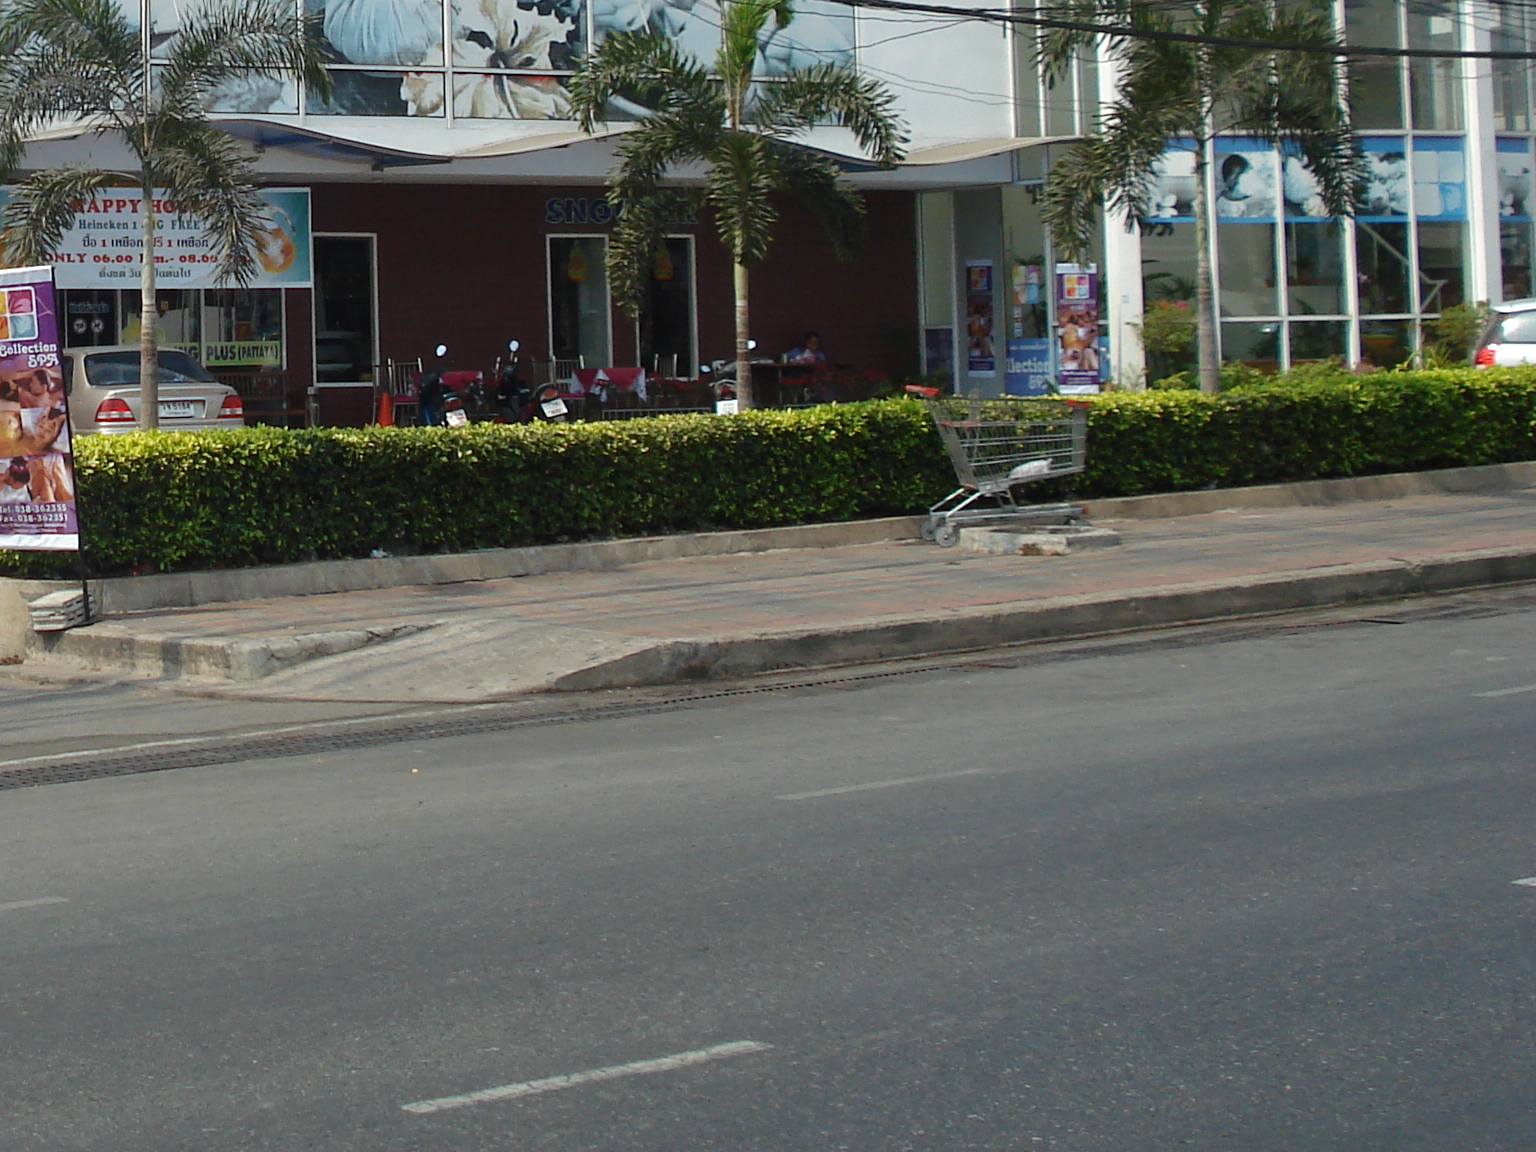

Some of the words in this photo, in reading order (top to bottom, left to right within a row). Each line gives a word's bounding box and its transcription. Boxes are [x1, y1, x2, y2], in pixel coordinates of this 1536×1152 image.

[78, 218, 129, 230] Heineken
[171, 219, 201, 230] FREE
[101, 239, 107, 248] 1
[167, 239, 173, 248] 1
[93, 253, 133, 263] 06.00
[206, 345, 236, 361] PLUS
[28, 353, 60, 368] SPA
